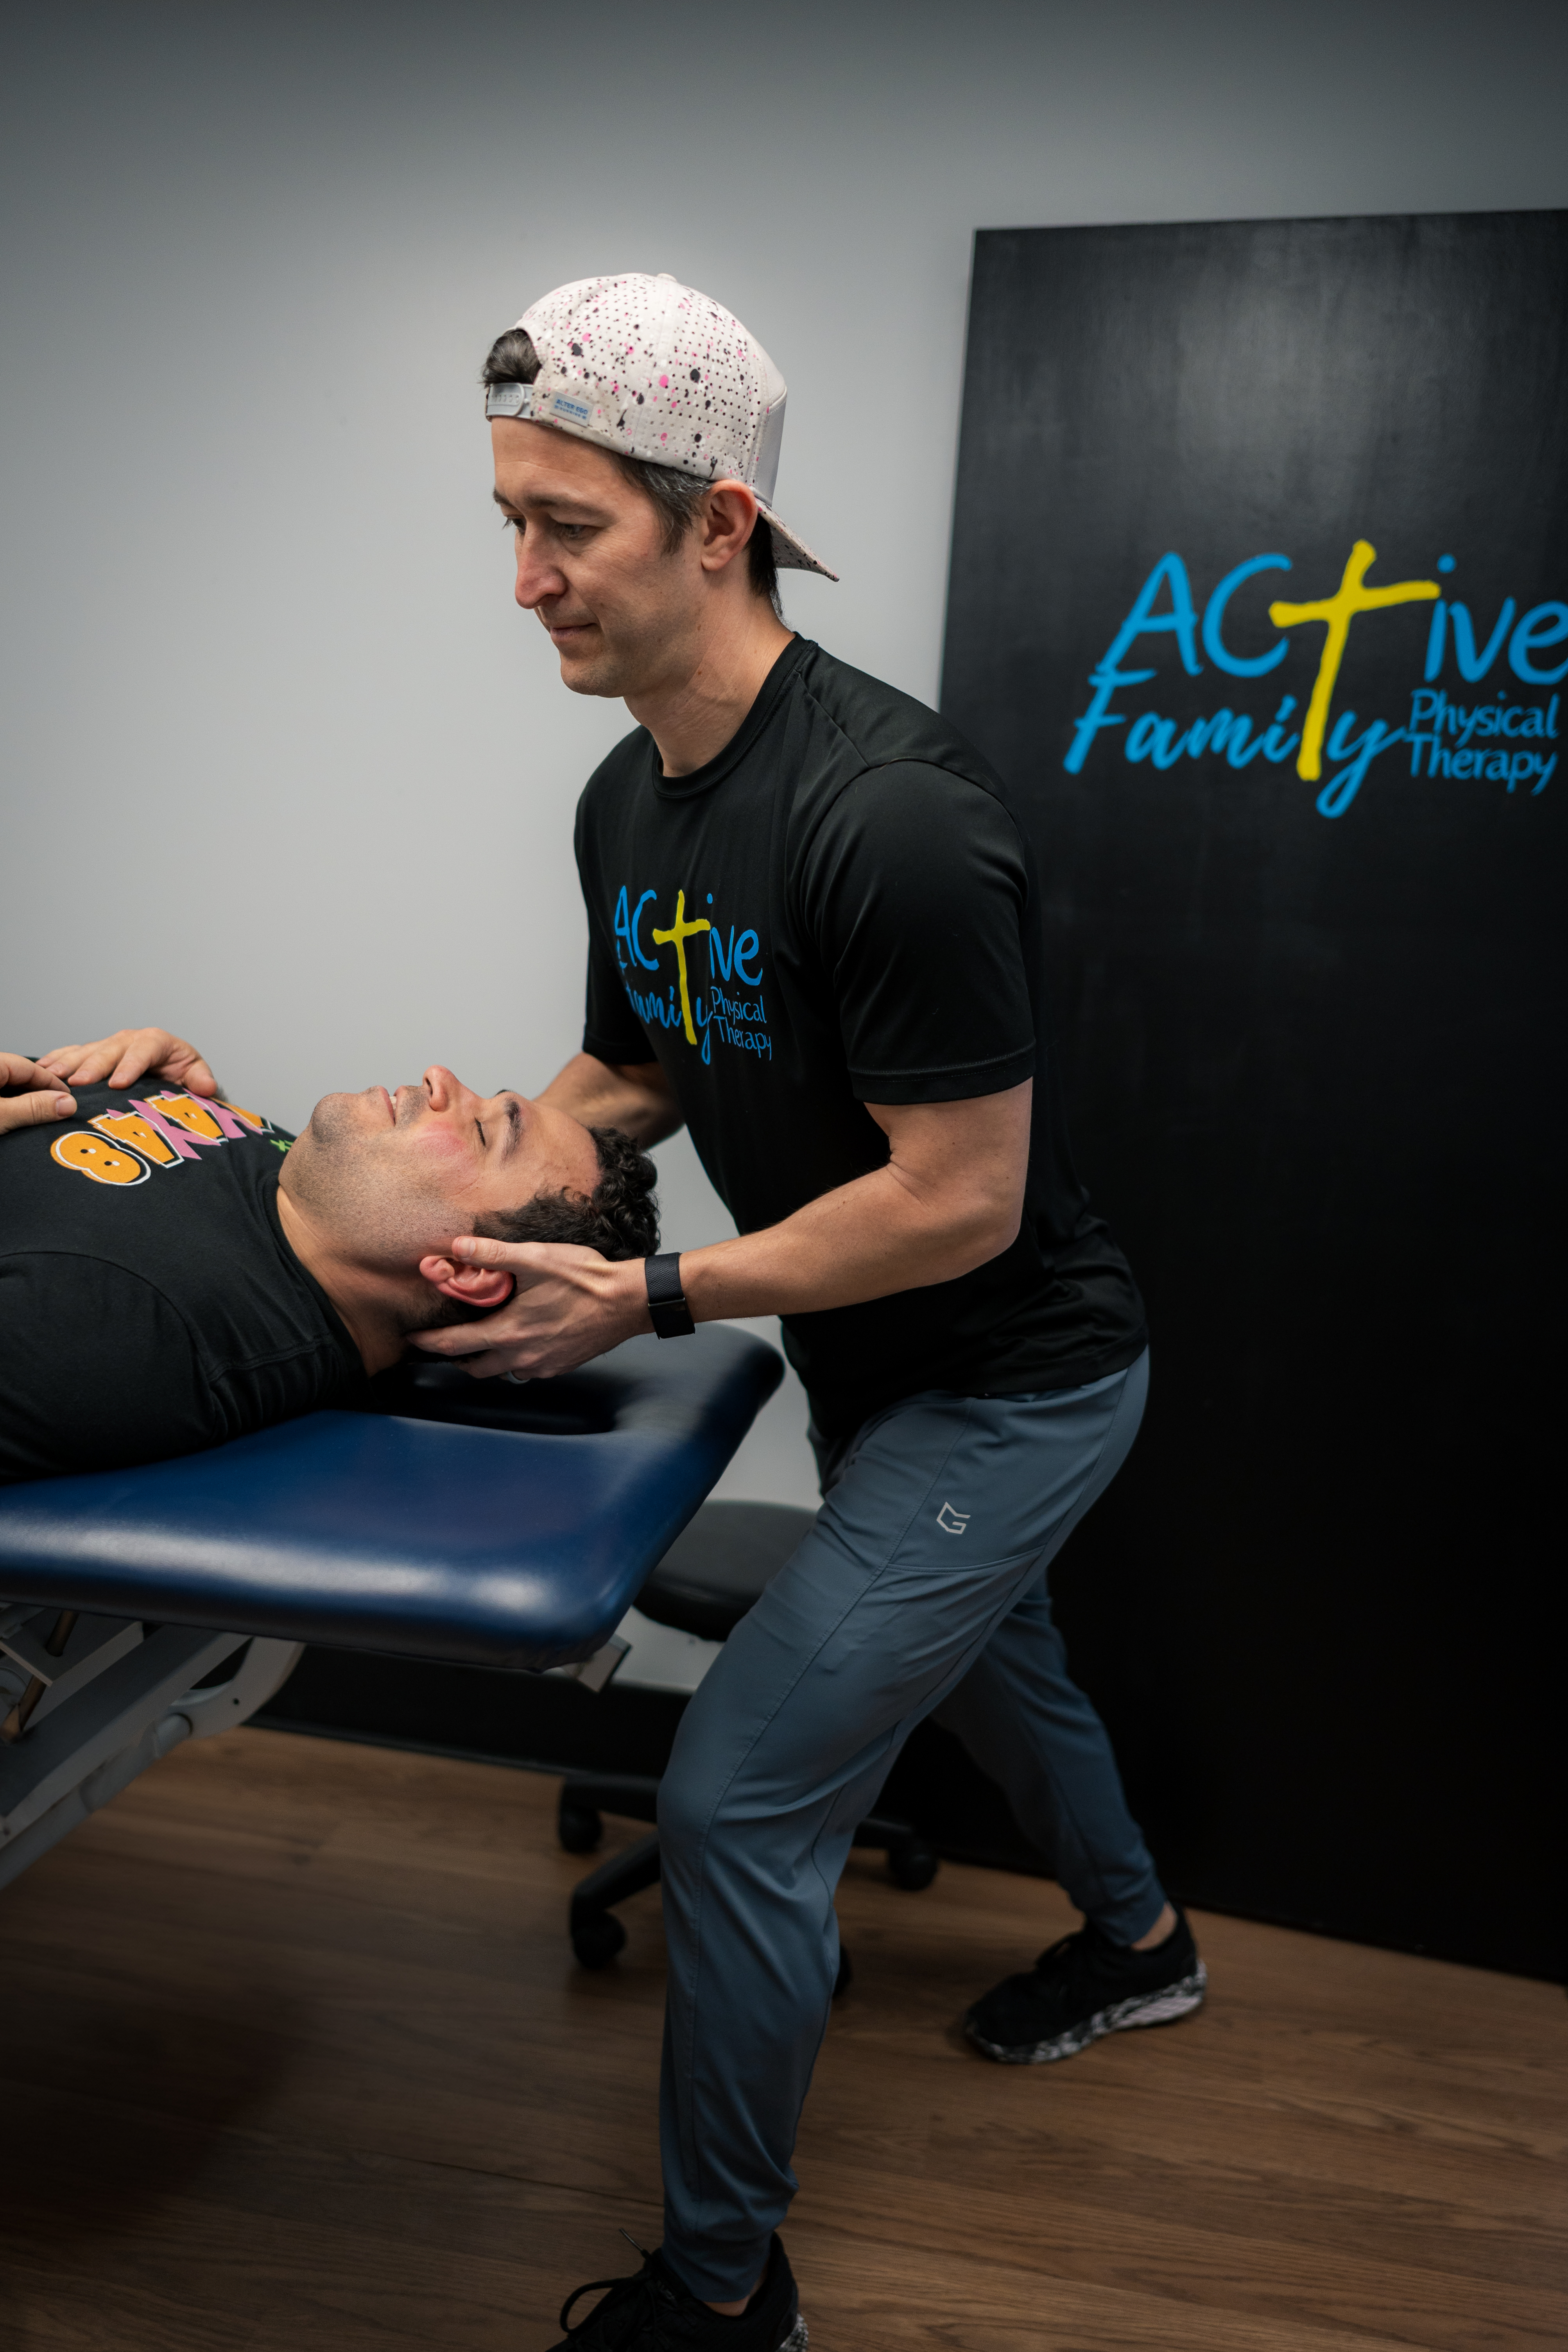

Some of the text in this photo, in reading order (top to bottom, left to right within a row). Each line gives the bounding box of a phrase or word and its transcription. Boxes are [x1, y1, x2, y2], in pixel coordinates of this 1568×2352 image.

[556, 399, 588, 415] ALTER EGO
[1063, 666, 1404, 819] Family
[1410, 688, 1560, 747] Physical
[1403, 732, 1558, 796] Therapy
[711, 986, 767, 1025] Physical
[713, 1016, 771, 1061] Therapy
